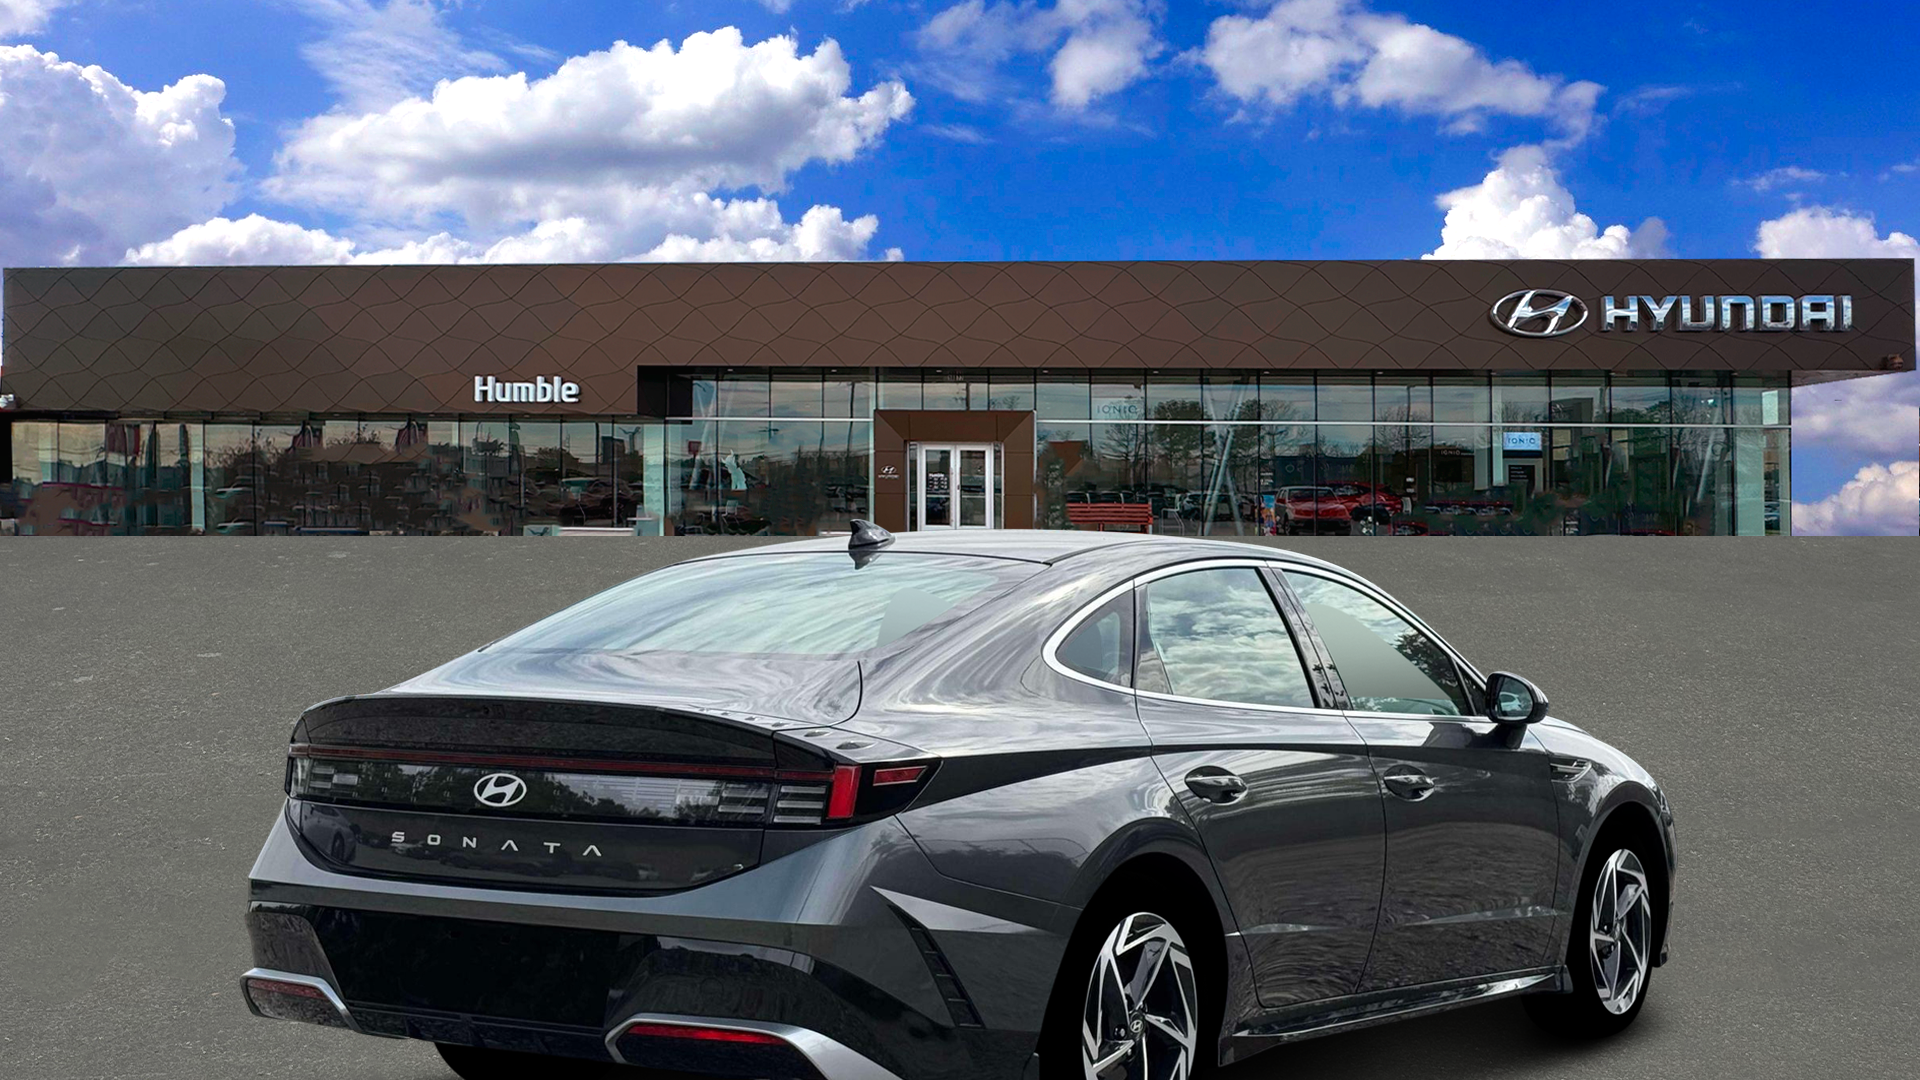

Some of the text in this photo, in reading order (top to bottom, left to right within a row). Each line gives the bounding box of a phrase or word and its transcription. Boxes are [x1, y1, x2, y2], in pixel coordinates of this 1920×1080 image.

[1601, 295, 1852, 332] HYUNDAI
[474, 376, 579, 402] Humble
[391, 831, 602, 857] SONATA
